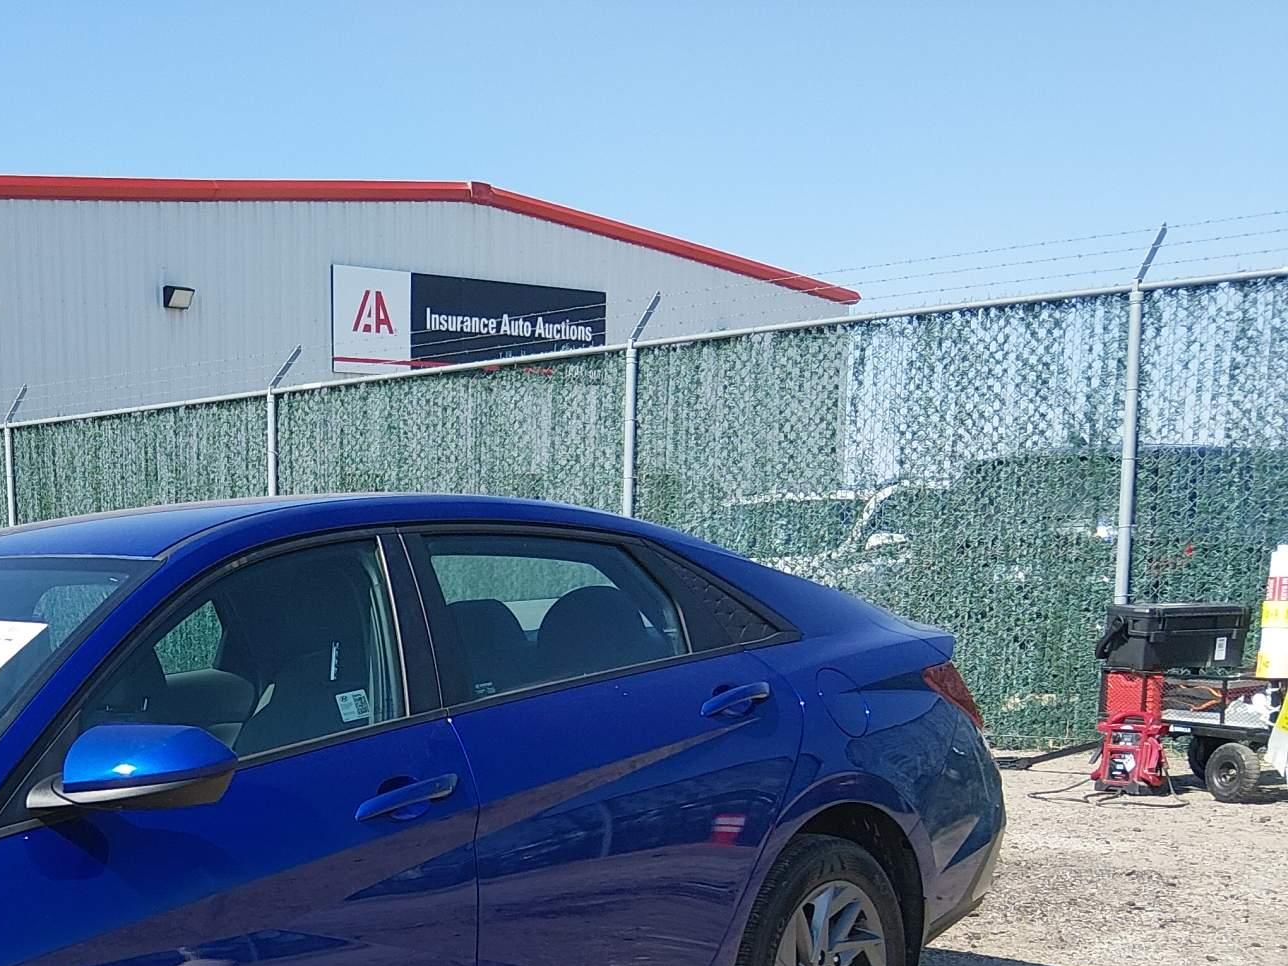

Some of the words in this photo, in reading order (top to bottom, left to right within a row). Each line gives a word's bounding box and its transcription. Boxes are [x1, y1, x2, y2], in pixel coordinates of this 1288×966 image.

[426, 307, 497, 334] Insurance
[500, 314, 532, 337] Auto
[535, 317, 593, 342] Auctions
